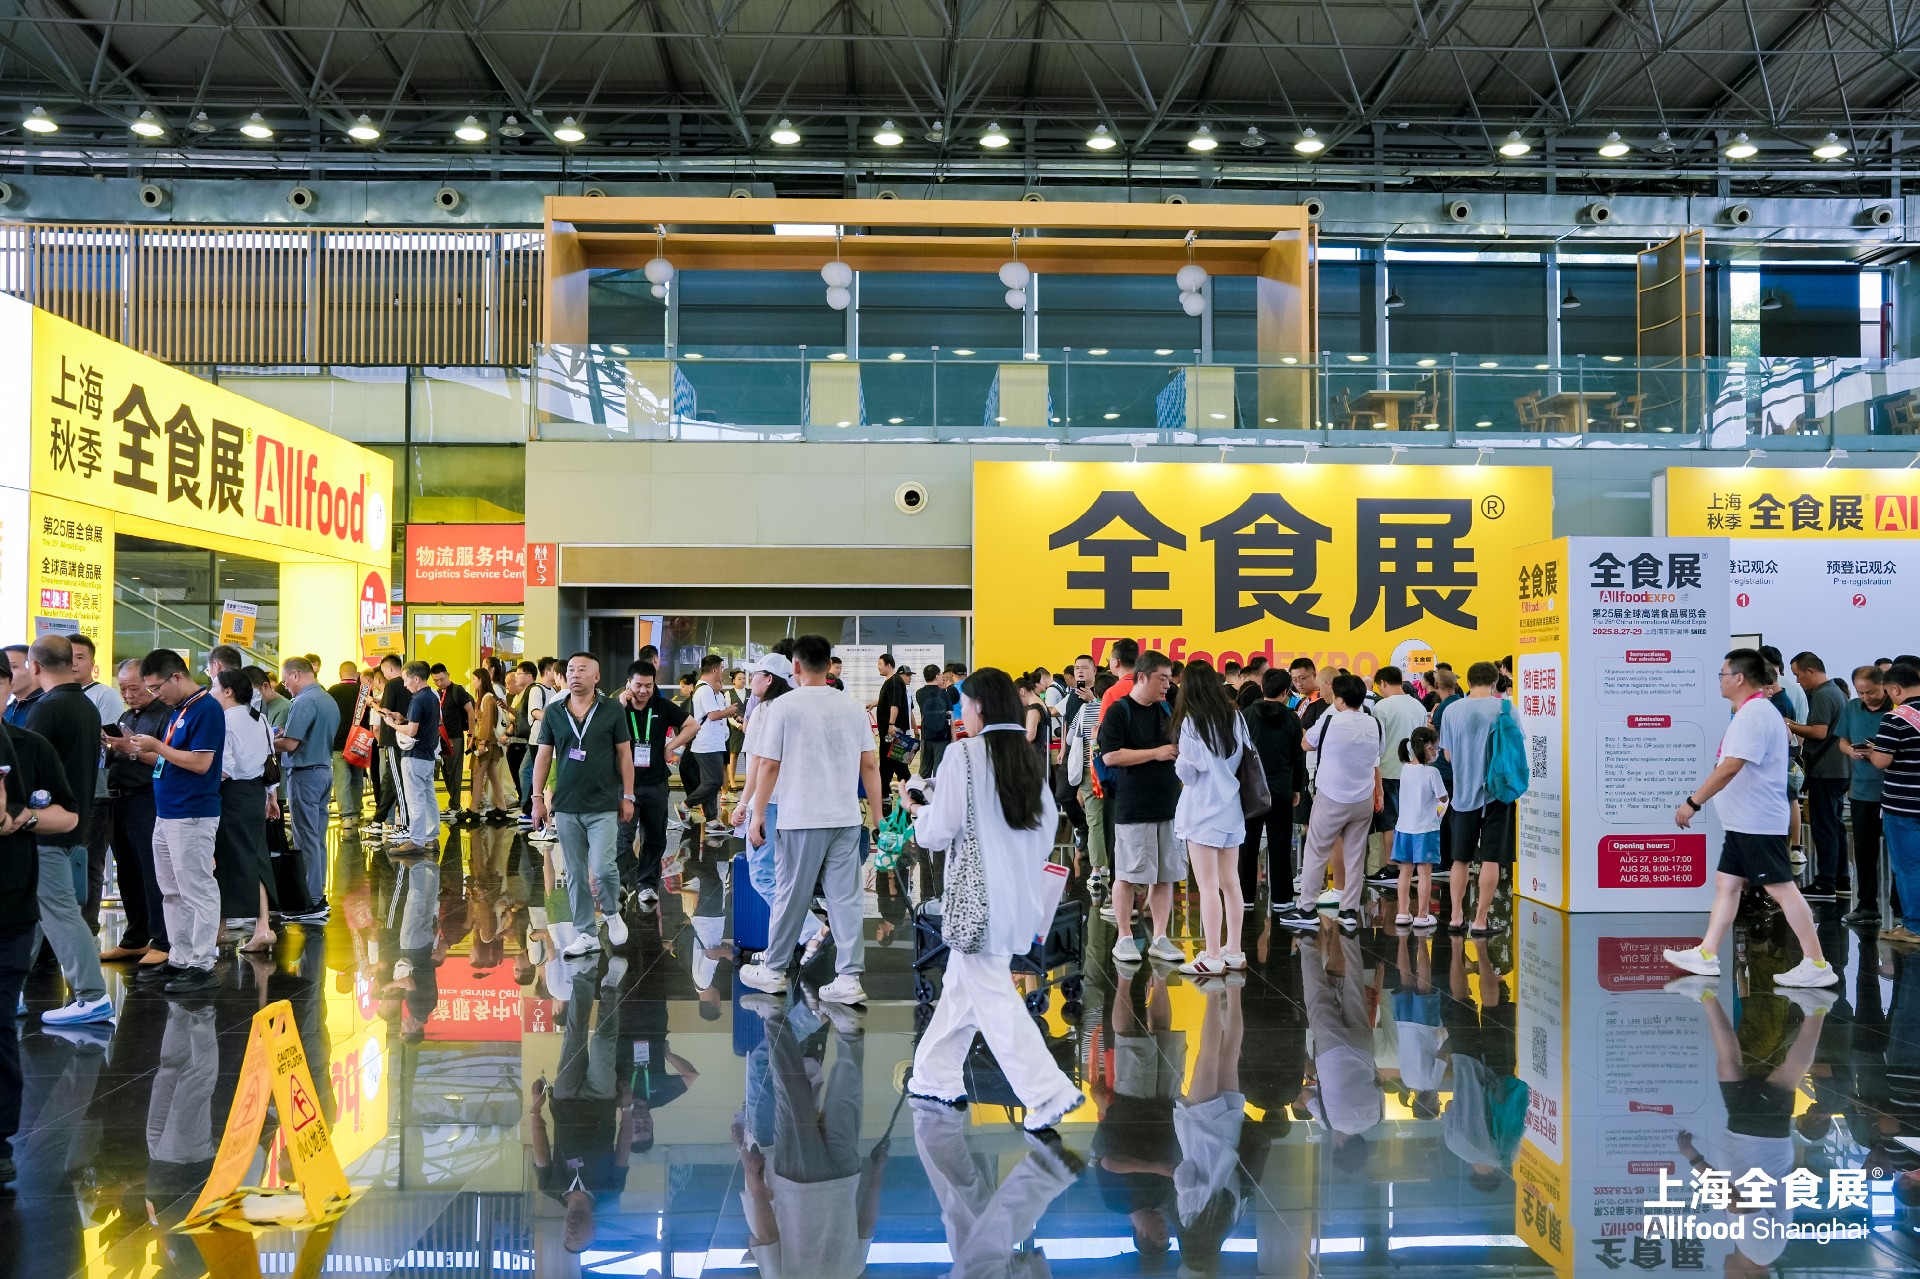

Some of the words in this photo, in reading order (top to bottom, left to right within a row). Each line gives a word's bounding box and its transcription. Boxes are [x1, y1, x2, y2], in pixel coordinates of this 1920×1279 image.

[51, 354, 104, 420] 上海
[50, 417, 102, 479] 秋季
[113, 383, 244, 517] 全食展
[255, 434, 364, 544] Allfood
[1707, 493, 1742, 510] 上海
[1749, 493, 1863, 531] 全食展
[43, 516, 103, 543] 第25届全食展
[1707, 513, 1742, 530] 秋季
[42, 557, 102, 580] 全球高端食品展
[1048, 490, 1478, 632] 全食展
[1590, 552, 1701, 589] 全食展
[1827, 560, 1896, 574] 预登记观众
[416, 569, 460, 580] Logistics
[463, 569, 500, 578] Service
[1519, 560, 1557, 600] 全食展
[1592, 608, 1706, 618] 第25届全球高端食品展览会
[1524, 668, 1555, 690] 微信扫码
[1524, 695, 1556, 716] 购票入场
[1640, 875, 1652, 883] 29,
[277, 1044, 298, 1063] CAUTION
[287, 1054, 303, 1069] FLOOR
